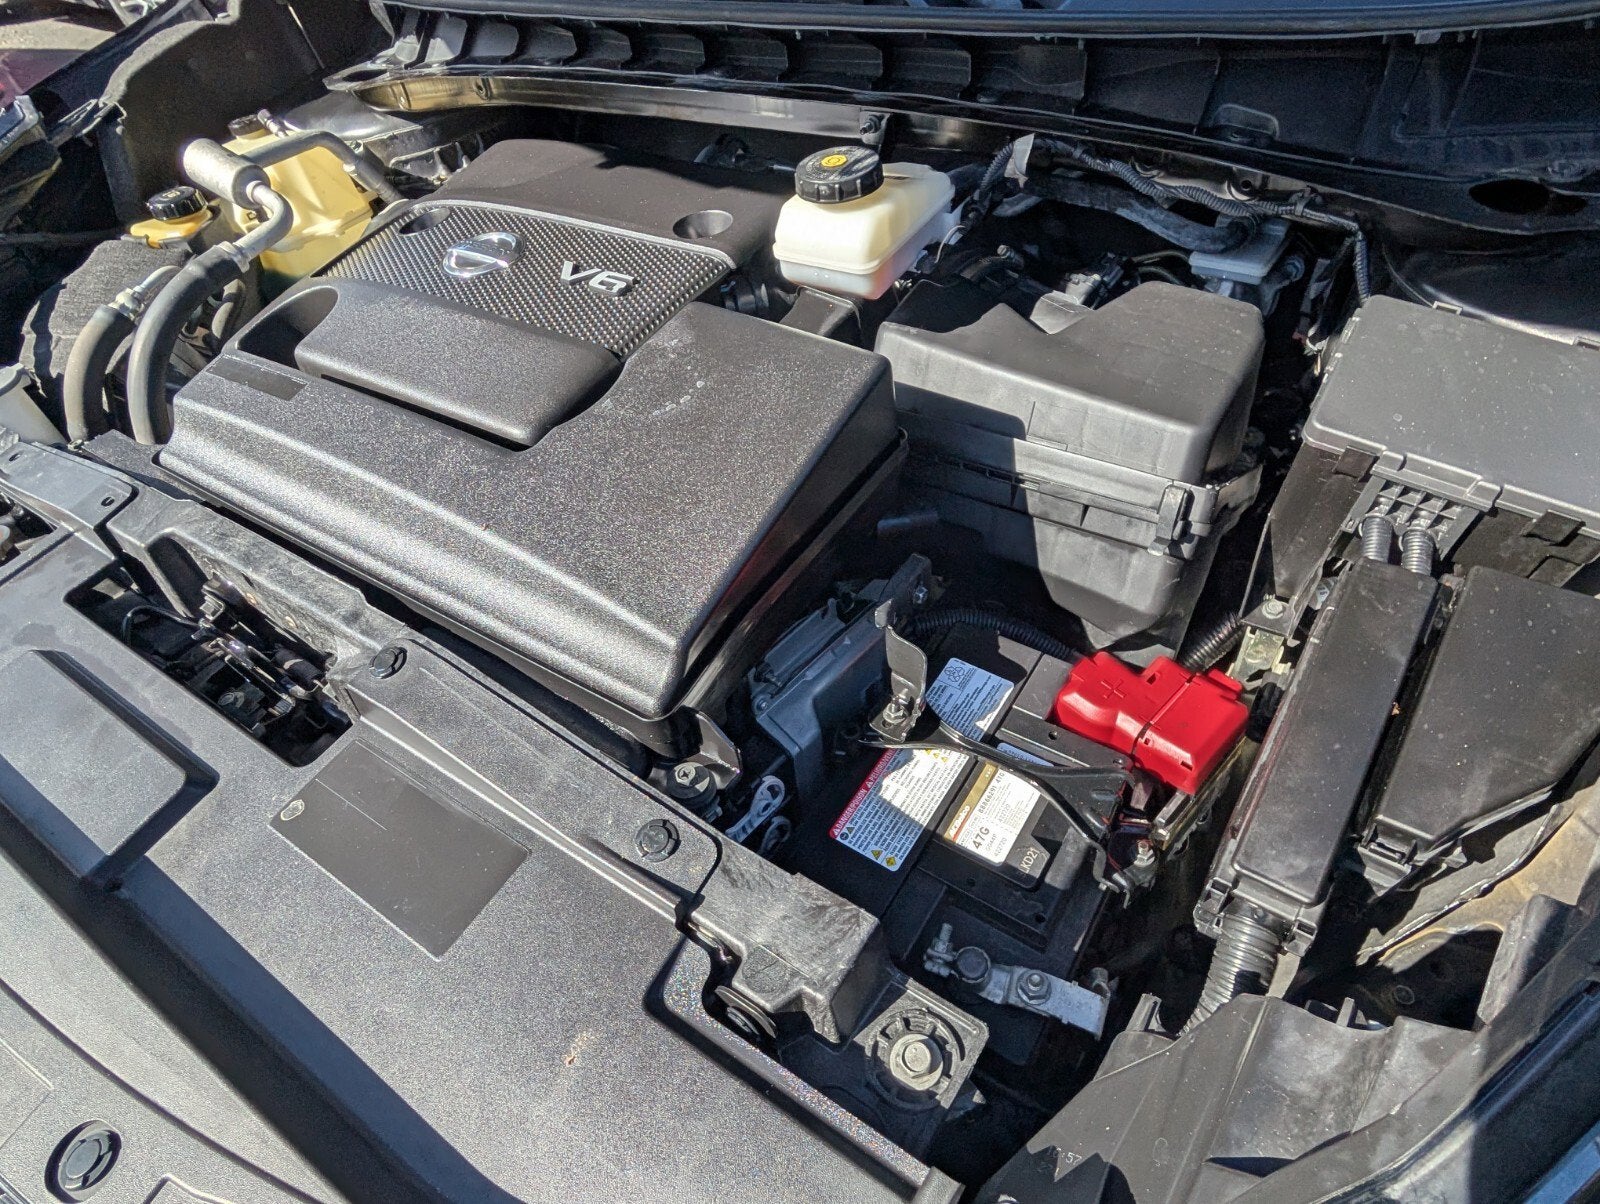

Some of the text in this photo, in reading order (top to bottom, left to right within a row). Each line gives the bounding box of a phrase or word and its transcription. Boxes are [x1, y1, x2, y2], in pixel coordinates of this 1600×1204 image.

[561, 260, 634, 294] V6
[838, 787, 868, 827] DANGER/POISON
[948, 805, 971, 837] ACDelco
[972, 825, 990, 850] 47G
